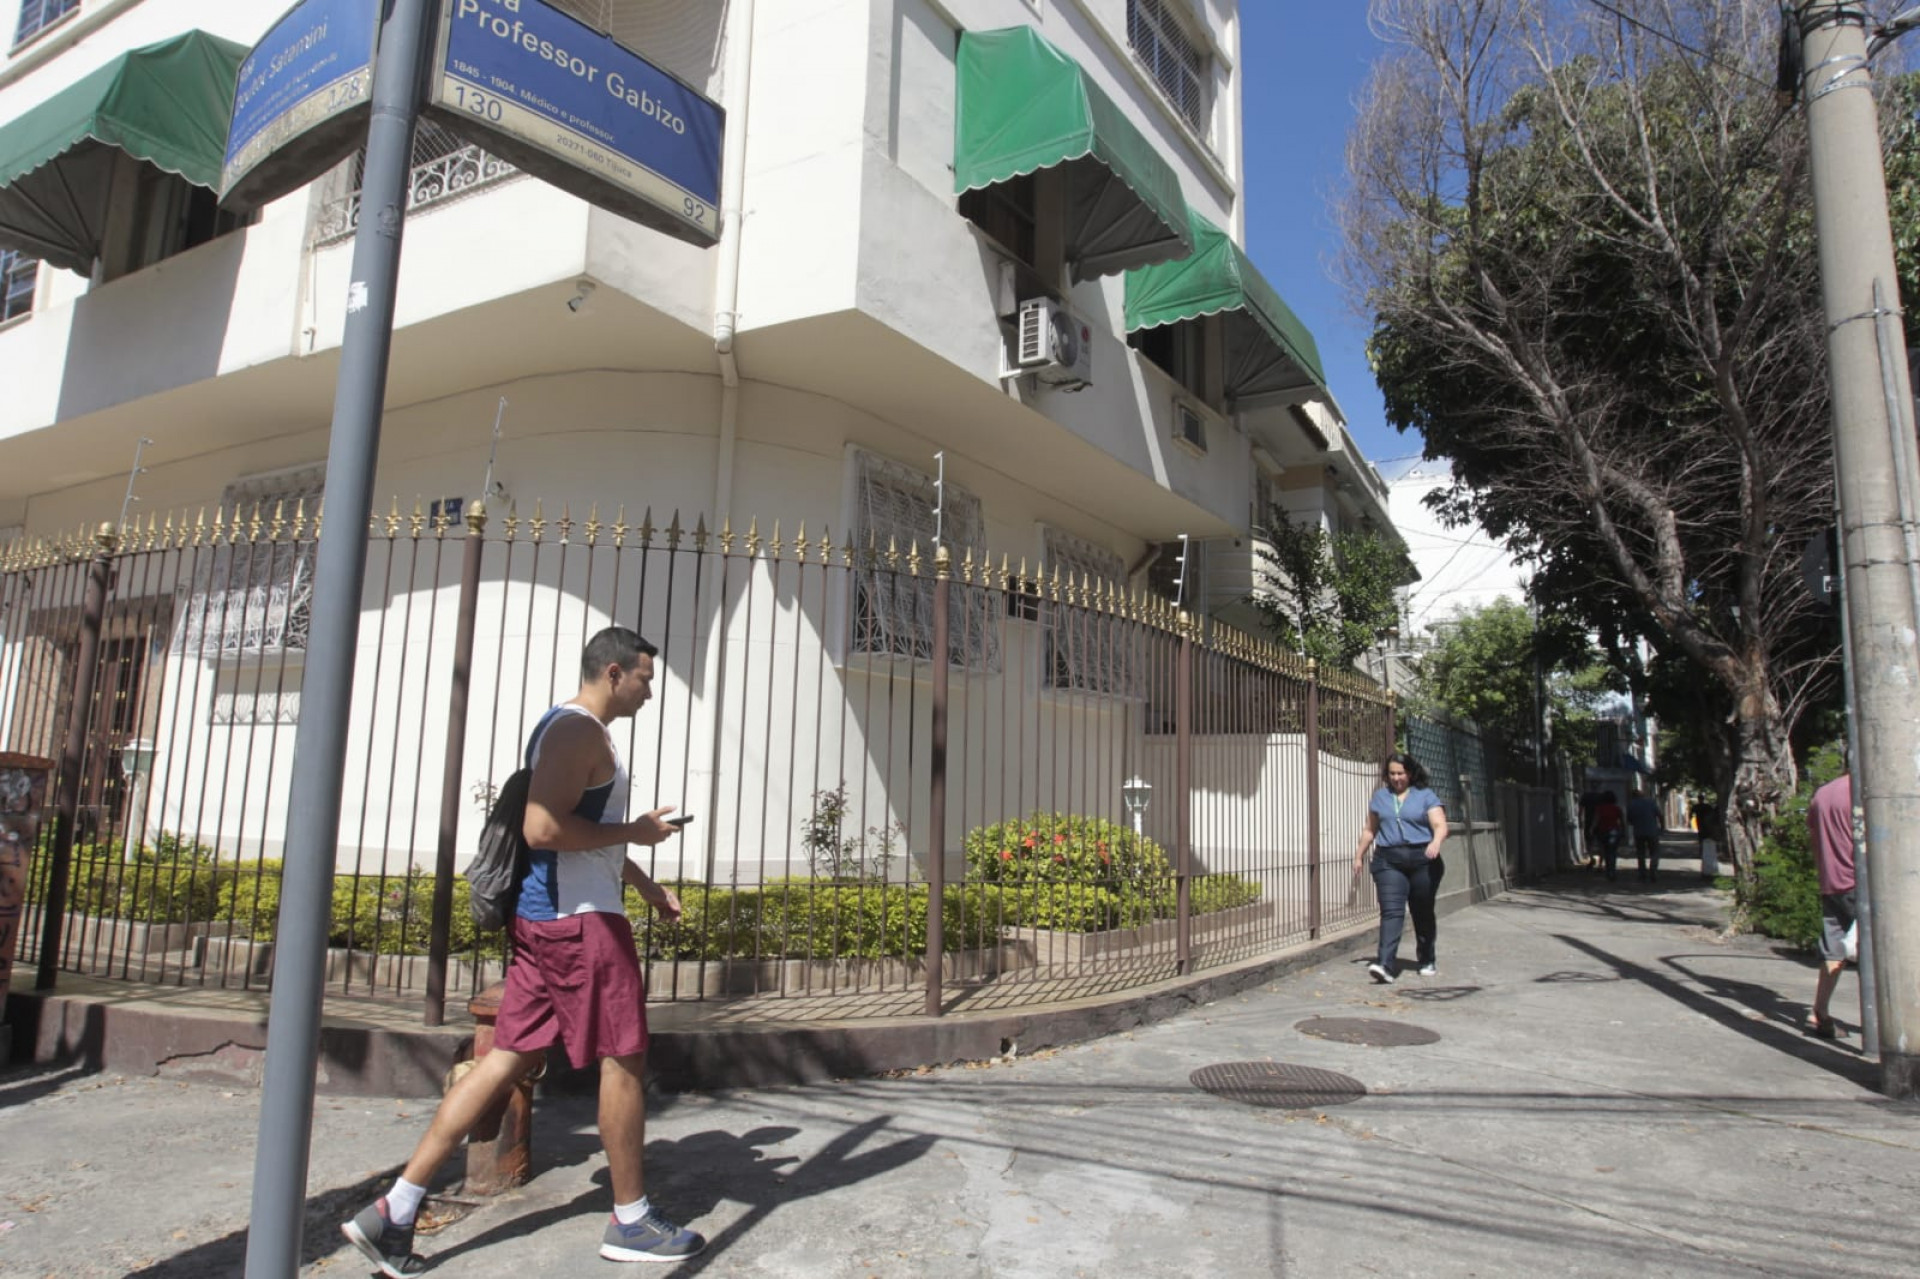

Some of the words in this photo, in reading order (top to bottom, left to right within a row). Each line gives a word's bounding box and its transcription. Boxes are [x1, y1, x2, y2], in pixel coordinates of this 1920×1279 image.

[453, 59, 480, 78] 1845
[561, 110, 567, 119] e
[459, 0, 598, 82] Professor
[606, 72, 684, 134] Gabizo
[455, 86, 502, 121] 130
[683, 197, 704, 224] 92
